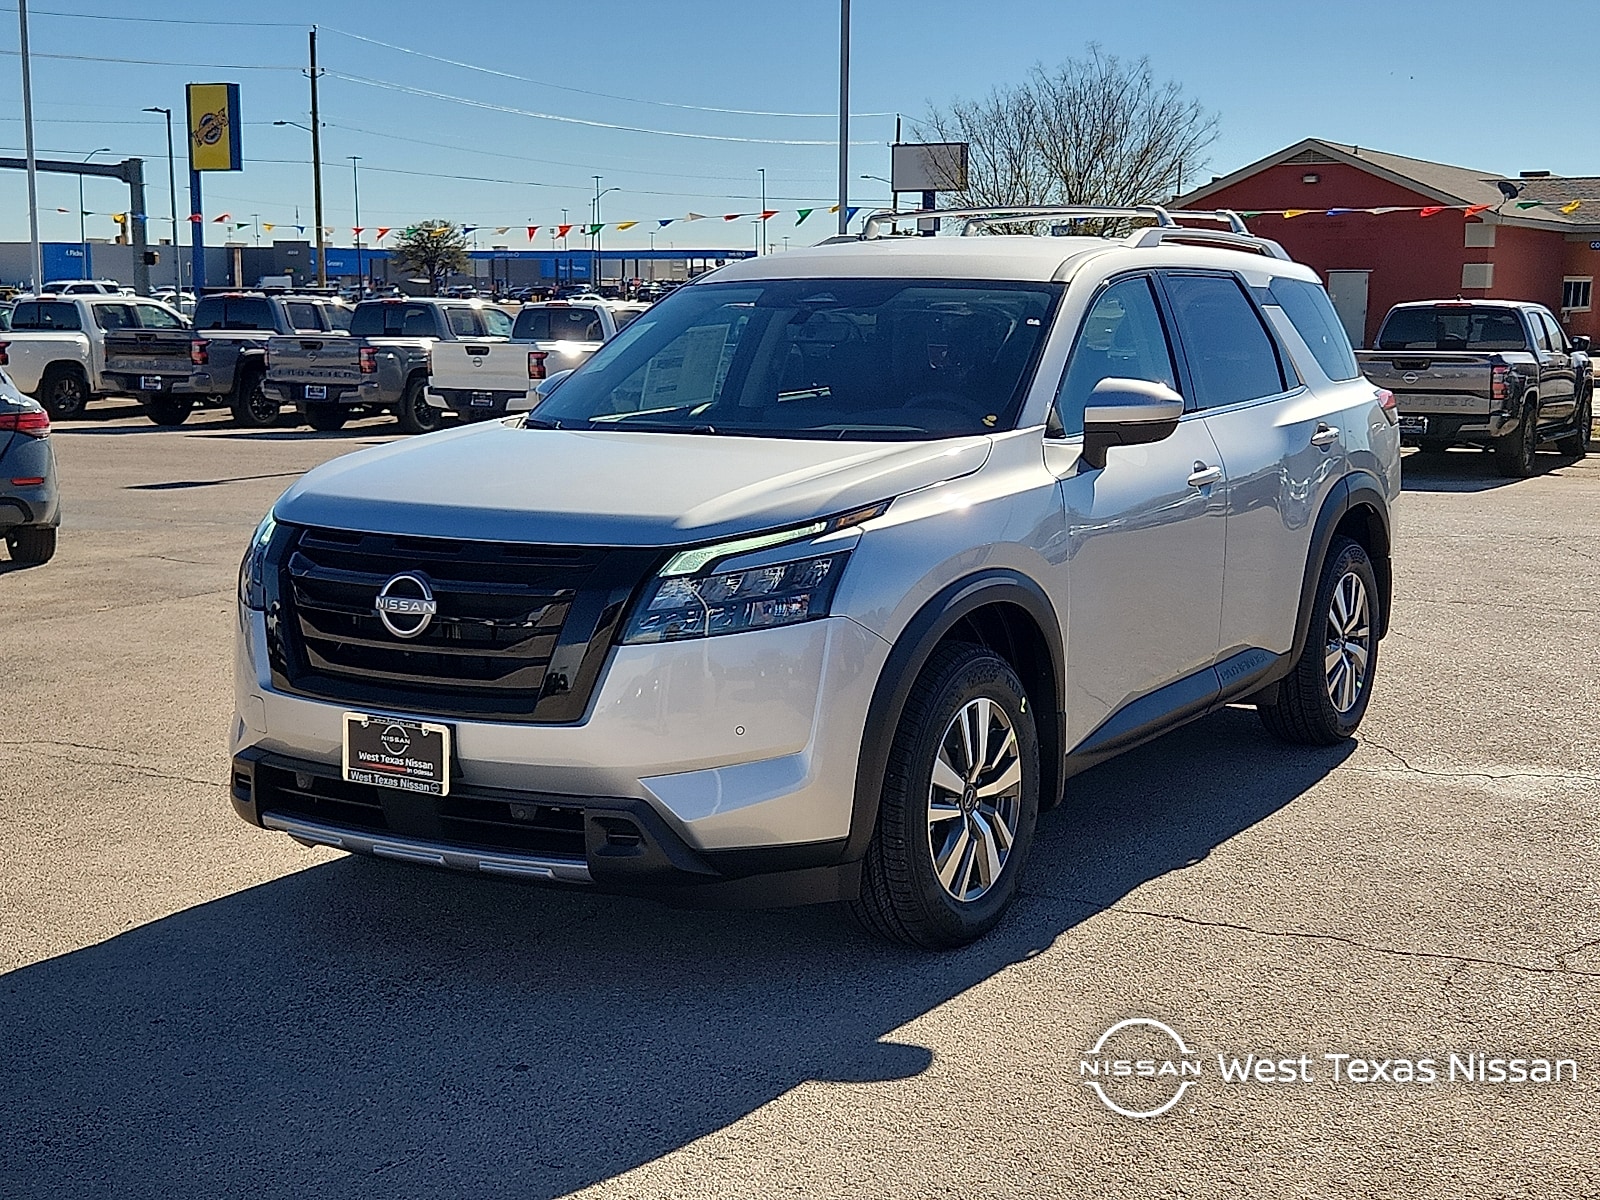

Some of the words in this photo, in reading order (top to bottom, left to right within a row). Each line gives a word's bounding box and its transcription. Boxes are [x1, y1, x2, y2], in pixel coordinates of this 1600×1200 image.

[1397, 396, 1476, 407] NTIER
[375, 596, 436, 613] NISSAN
[381, 734, 411, 744] NISSAN
[358, 751, 380, 762] West
[380, 754, 405, 767] Texas
[405, 758, 434, 771] Nissan
[350, 770, 373, 783] West
[373, 774, 399, 787] Texas
[400, 778, 430, 792] Nissan
